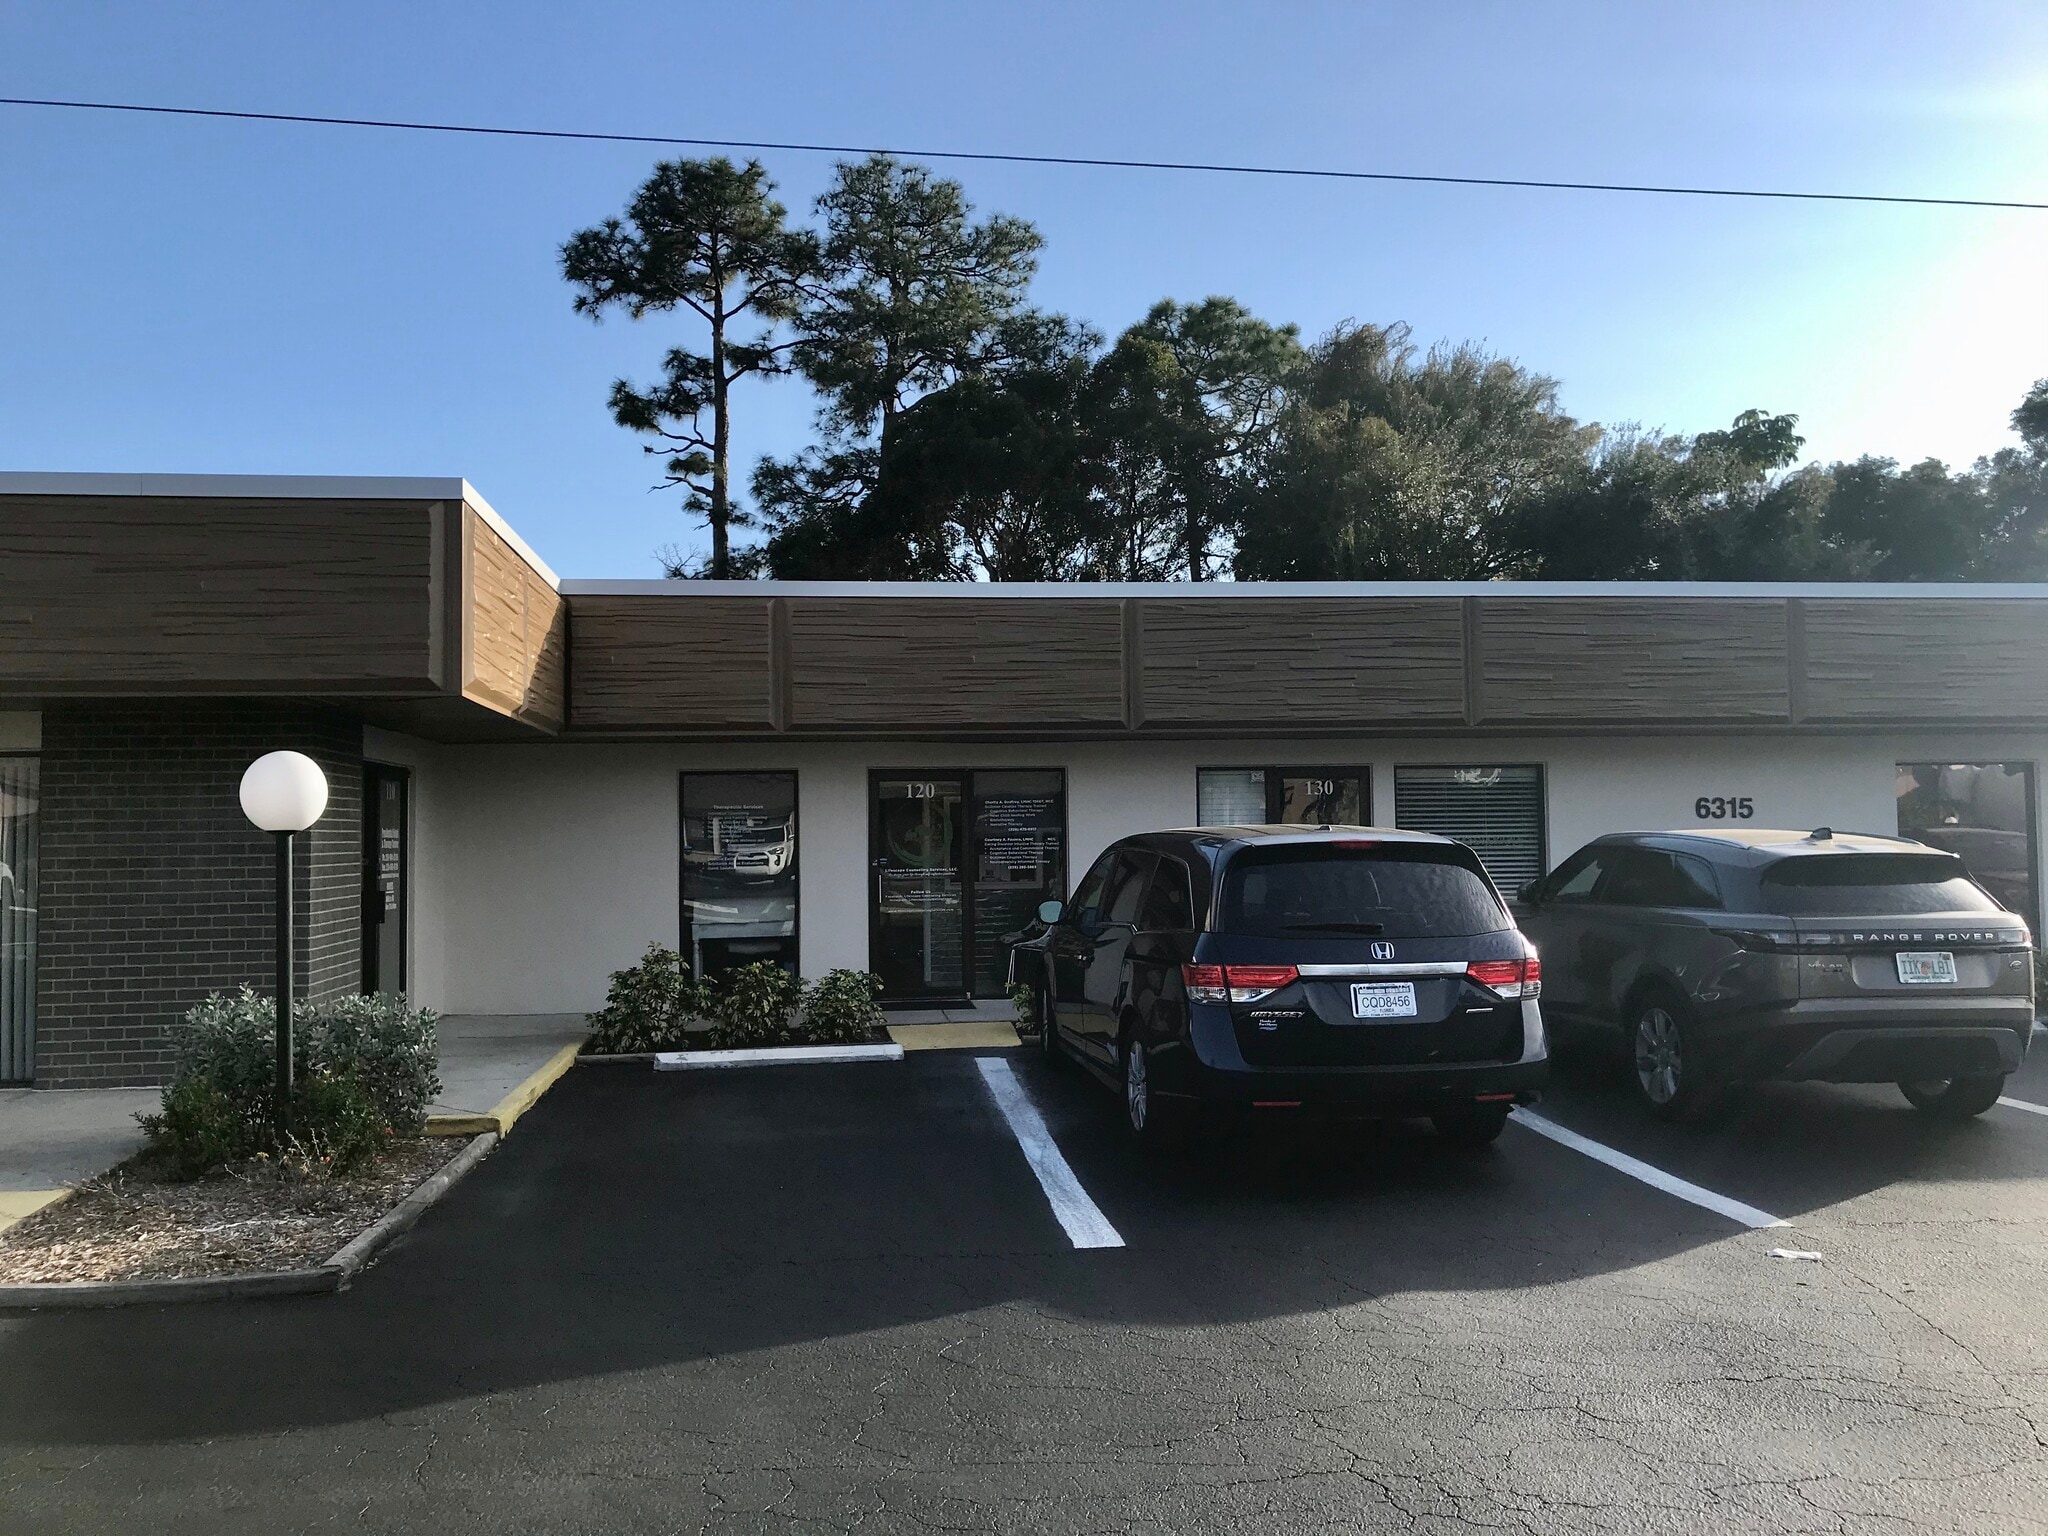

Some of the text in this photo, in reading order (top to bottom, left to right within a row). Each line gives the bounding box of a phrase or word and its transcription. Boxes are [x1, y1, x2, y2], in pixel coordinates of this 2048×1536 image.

[906, 783, 935, 799] 120
[1305, 780, 1334, 796] 130
[1695, 797, 1754, 819] 6315
[1853, 932, 1995, 941] RANGE ROVER
[1362, 995, 1411, 1009] CQD8456
